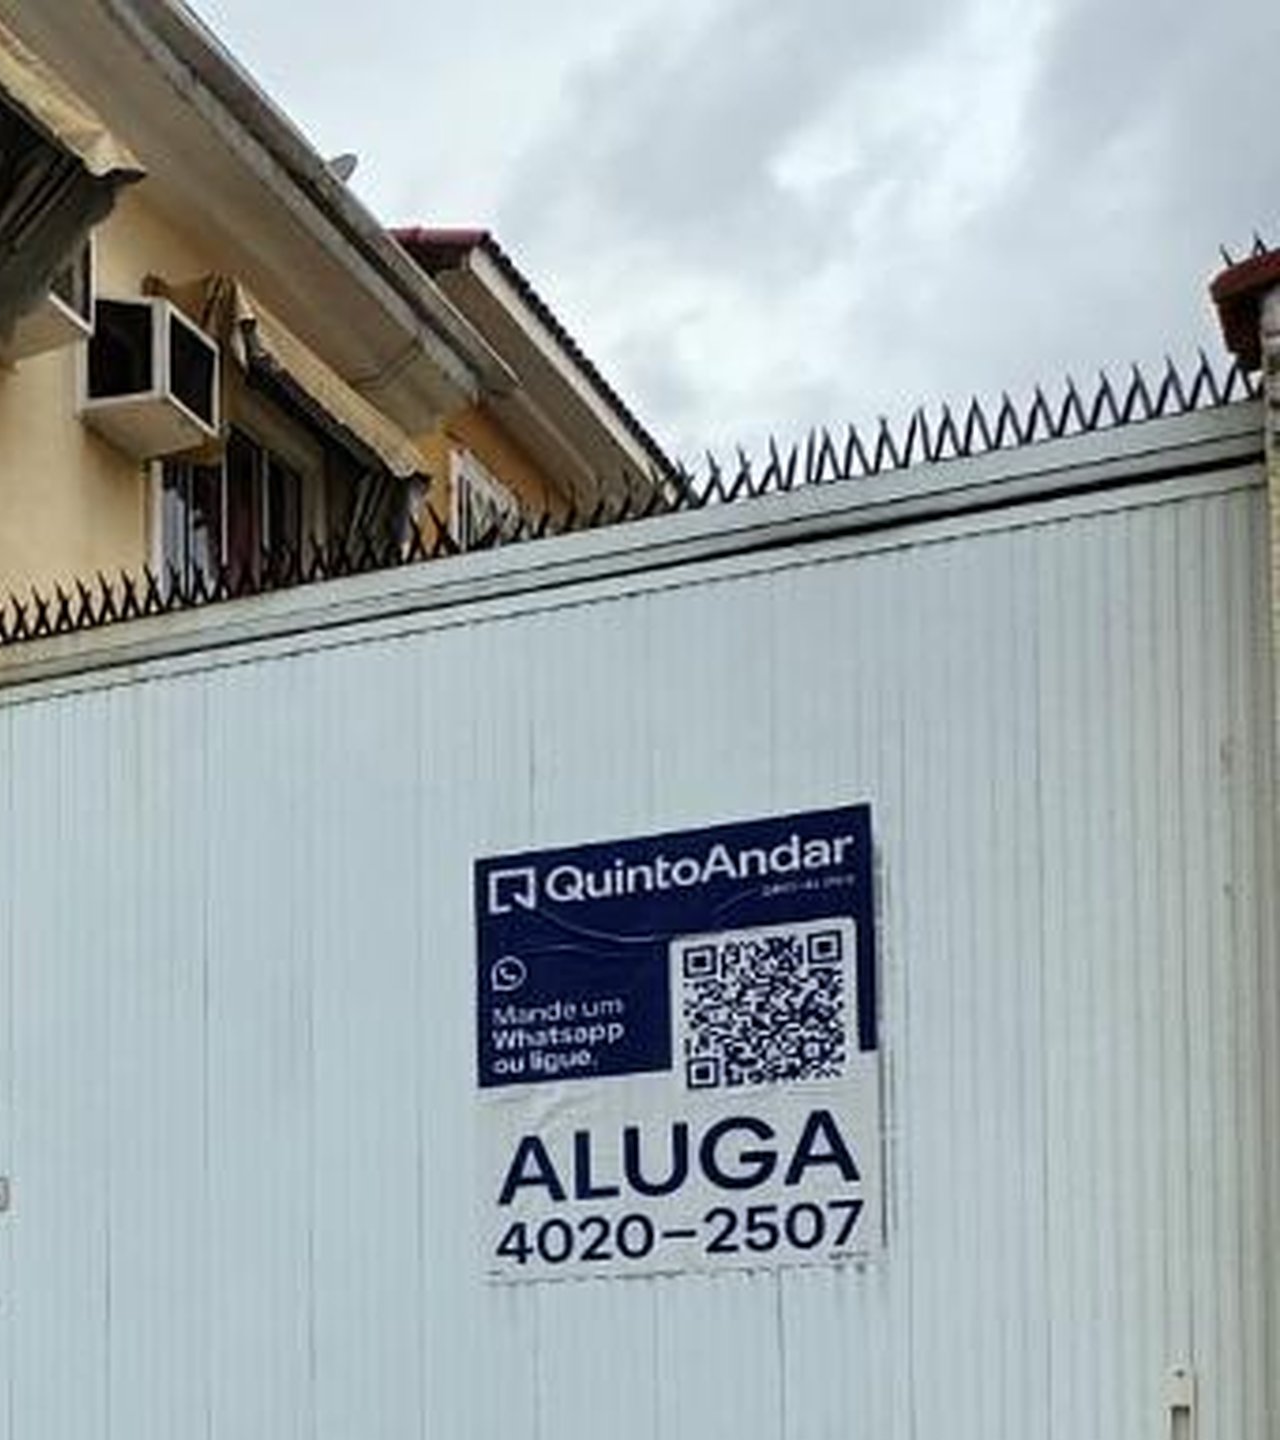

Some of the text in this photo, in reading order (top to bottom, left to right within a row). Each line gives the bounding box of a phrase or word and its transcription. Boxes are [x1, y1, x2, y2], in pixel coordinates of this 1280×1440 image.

[546, 834, 854, 902] QuintoAndar
[581, 998, 625, 1018] um
[493, 1056, 525, 1074] ou
[497, 1110, 860, 1205] ALUGA
[496, 1199, 864, 1265] 4020-2507
